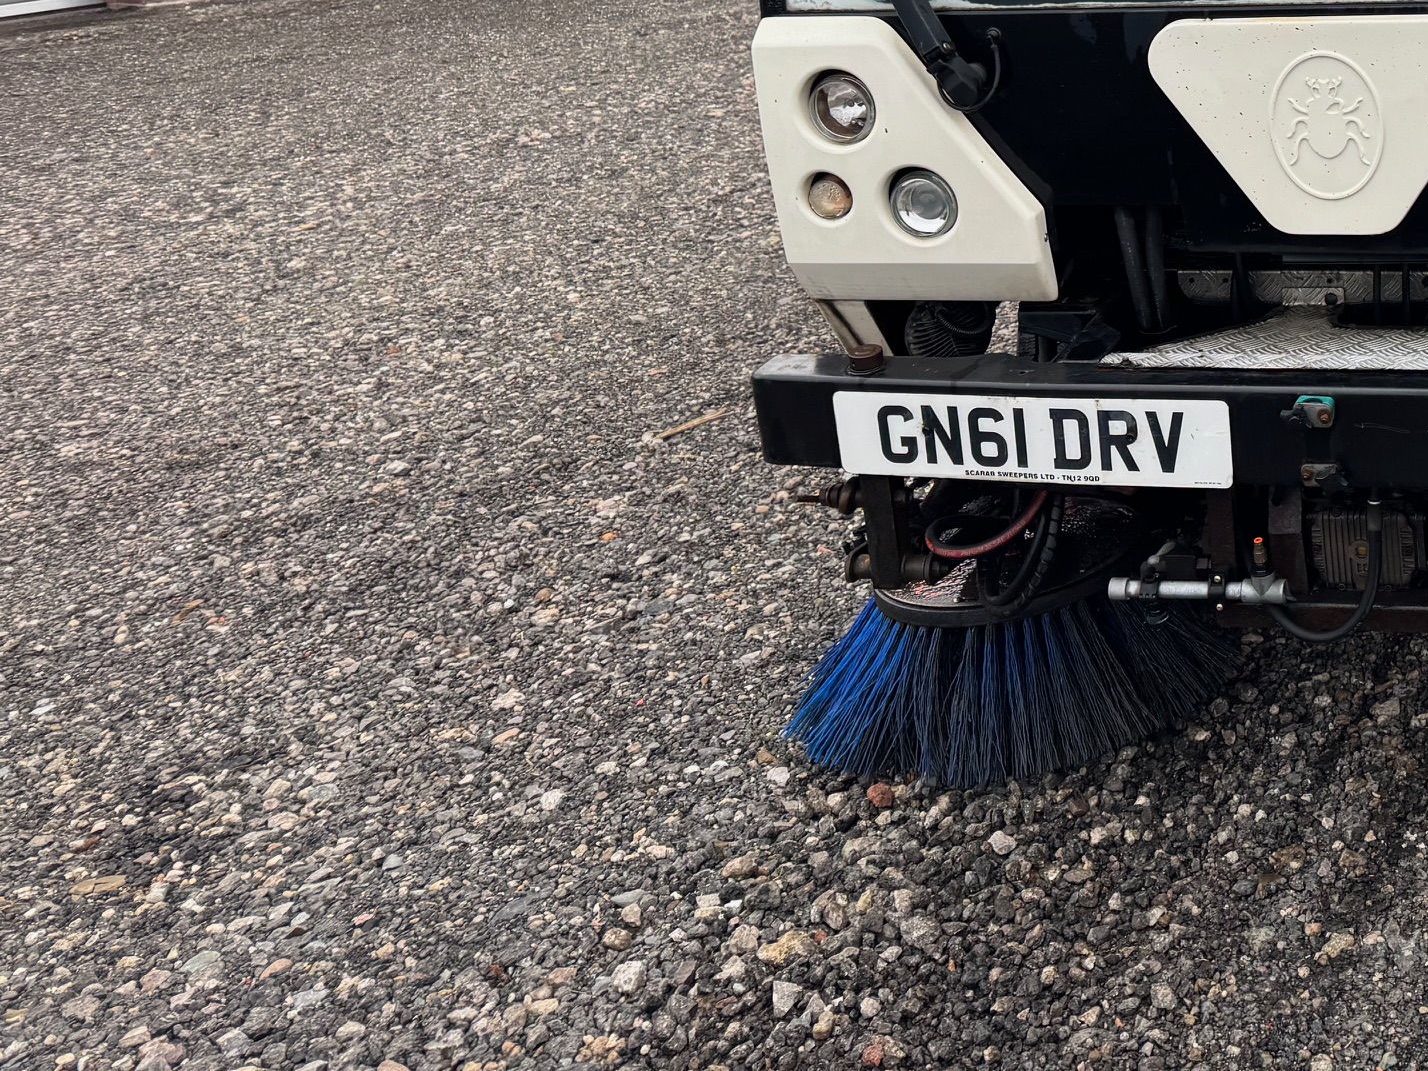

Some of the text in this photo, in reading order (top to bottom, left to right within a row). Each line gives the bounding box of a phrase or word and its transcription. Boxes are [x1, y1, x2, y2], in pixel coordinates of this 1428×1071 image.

[877, 404, 1184, 473] GN61 DRV
[965, 469, 996, 477] SCARAB
[997, 471, 1039, 480] SWEEPERS
[1040, 473, 1055, 481] LTD
[1061, 474, 1082, 483] TN12
[1083, 475, 1100, 483] 9QD
